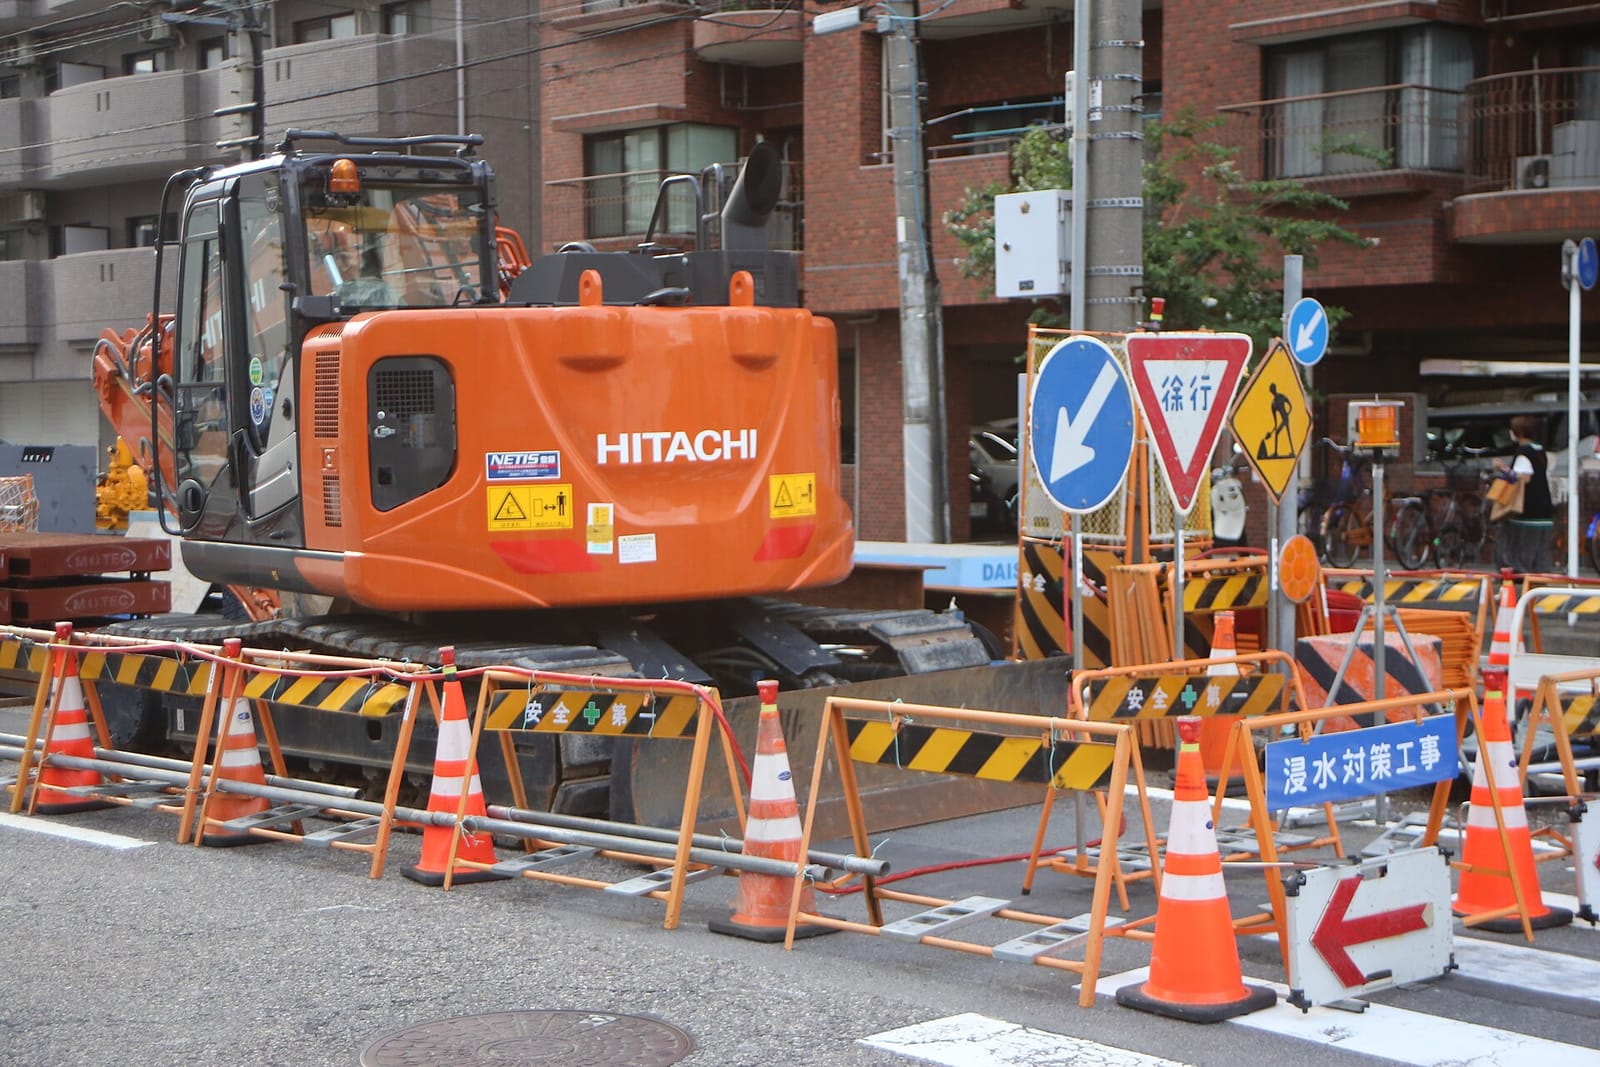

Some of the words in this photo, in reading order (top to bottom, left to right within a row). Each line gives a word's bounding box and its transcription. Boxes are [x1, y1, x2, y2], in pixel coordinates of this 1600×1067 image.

[1161, 374, 1212, 412] 徐行
[490, 453, 540, 466] NETIS
[597, 429, 758, 465] HITACHI
[1283, 734, 1441, 796] 浸水対策工事
